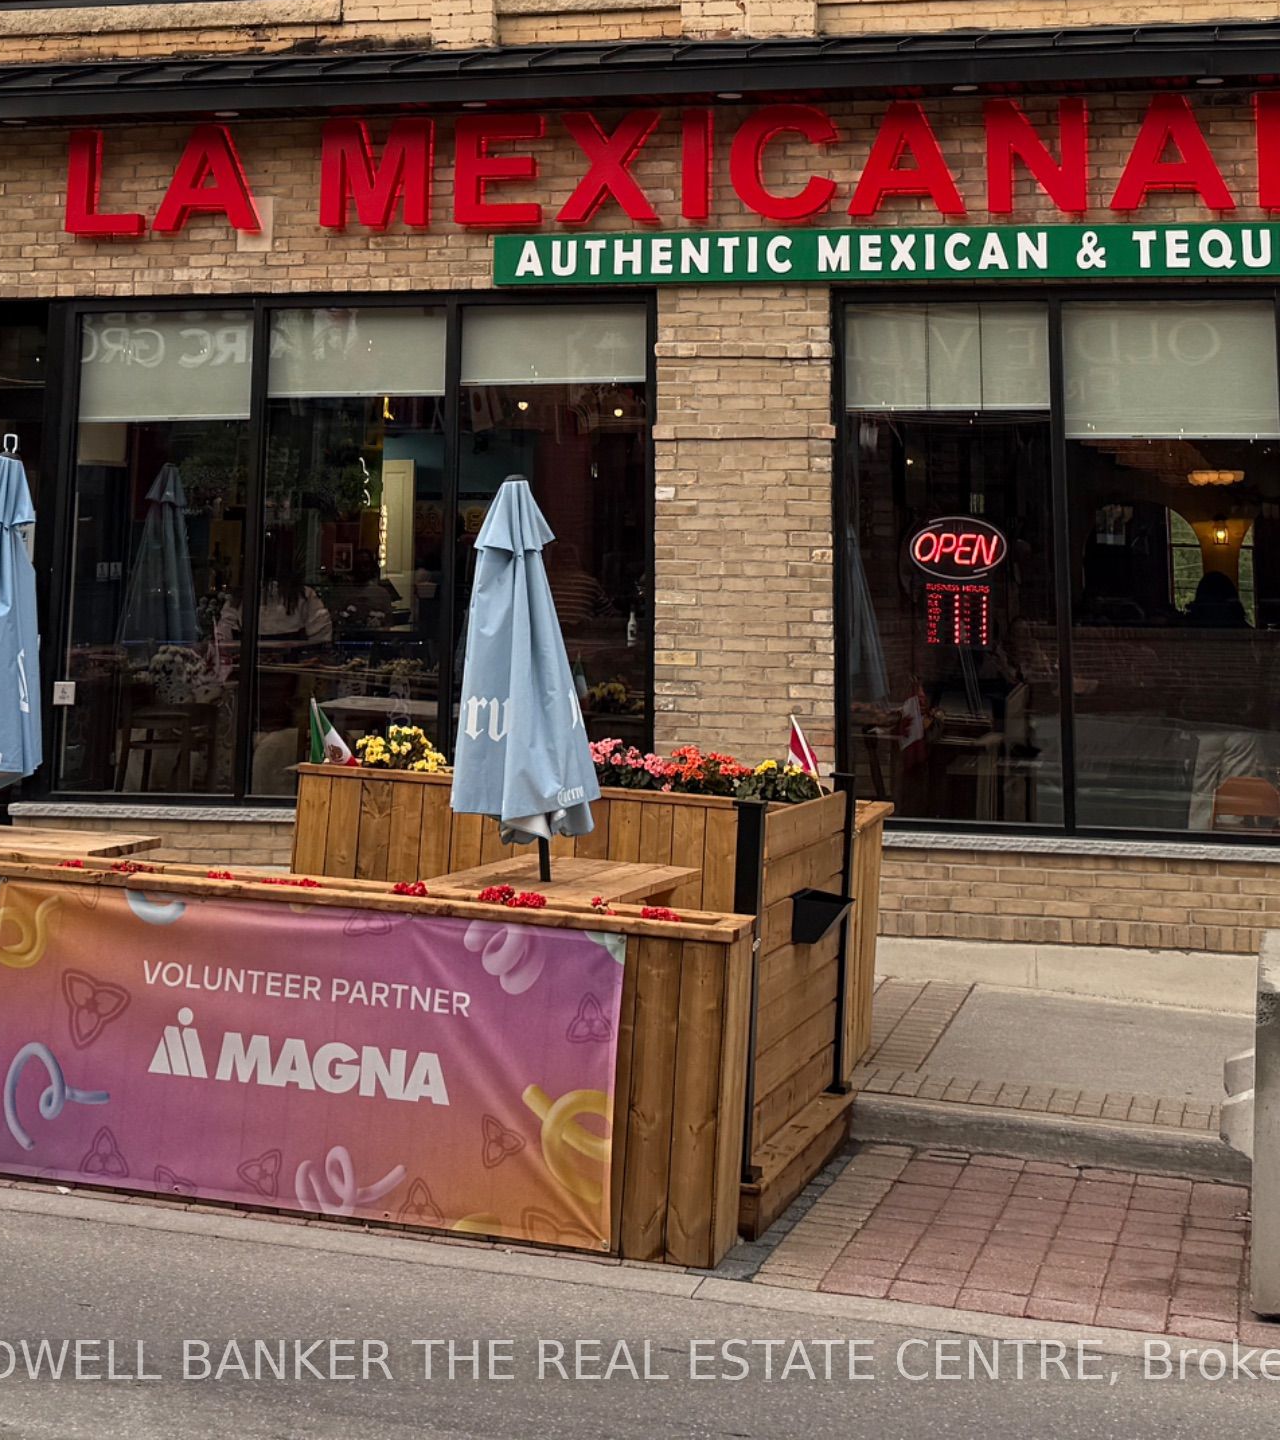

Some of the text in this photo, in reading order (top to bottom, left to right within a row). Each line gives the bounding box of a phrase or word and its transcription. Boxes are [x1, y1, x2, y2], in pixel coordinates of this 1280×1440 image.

[64, 122, 266, 236] LA
[515, 235, 793, 278] AUTHENTIC
[817, 231, 1049, 272] MEXICAN
[1075, 231, 1107, 269] &
[914, 531, 999, 566] OPEN
[925, 583, 990, 593] BUSINESS HOURS
[143, 959, 471, 1018] VOLUNTEER PARTNER
[215, 1031, 450, 1106] MAGNA
